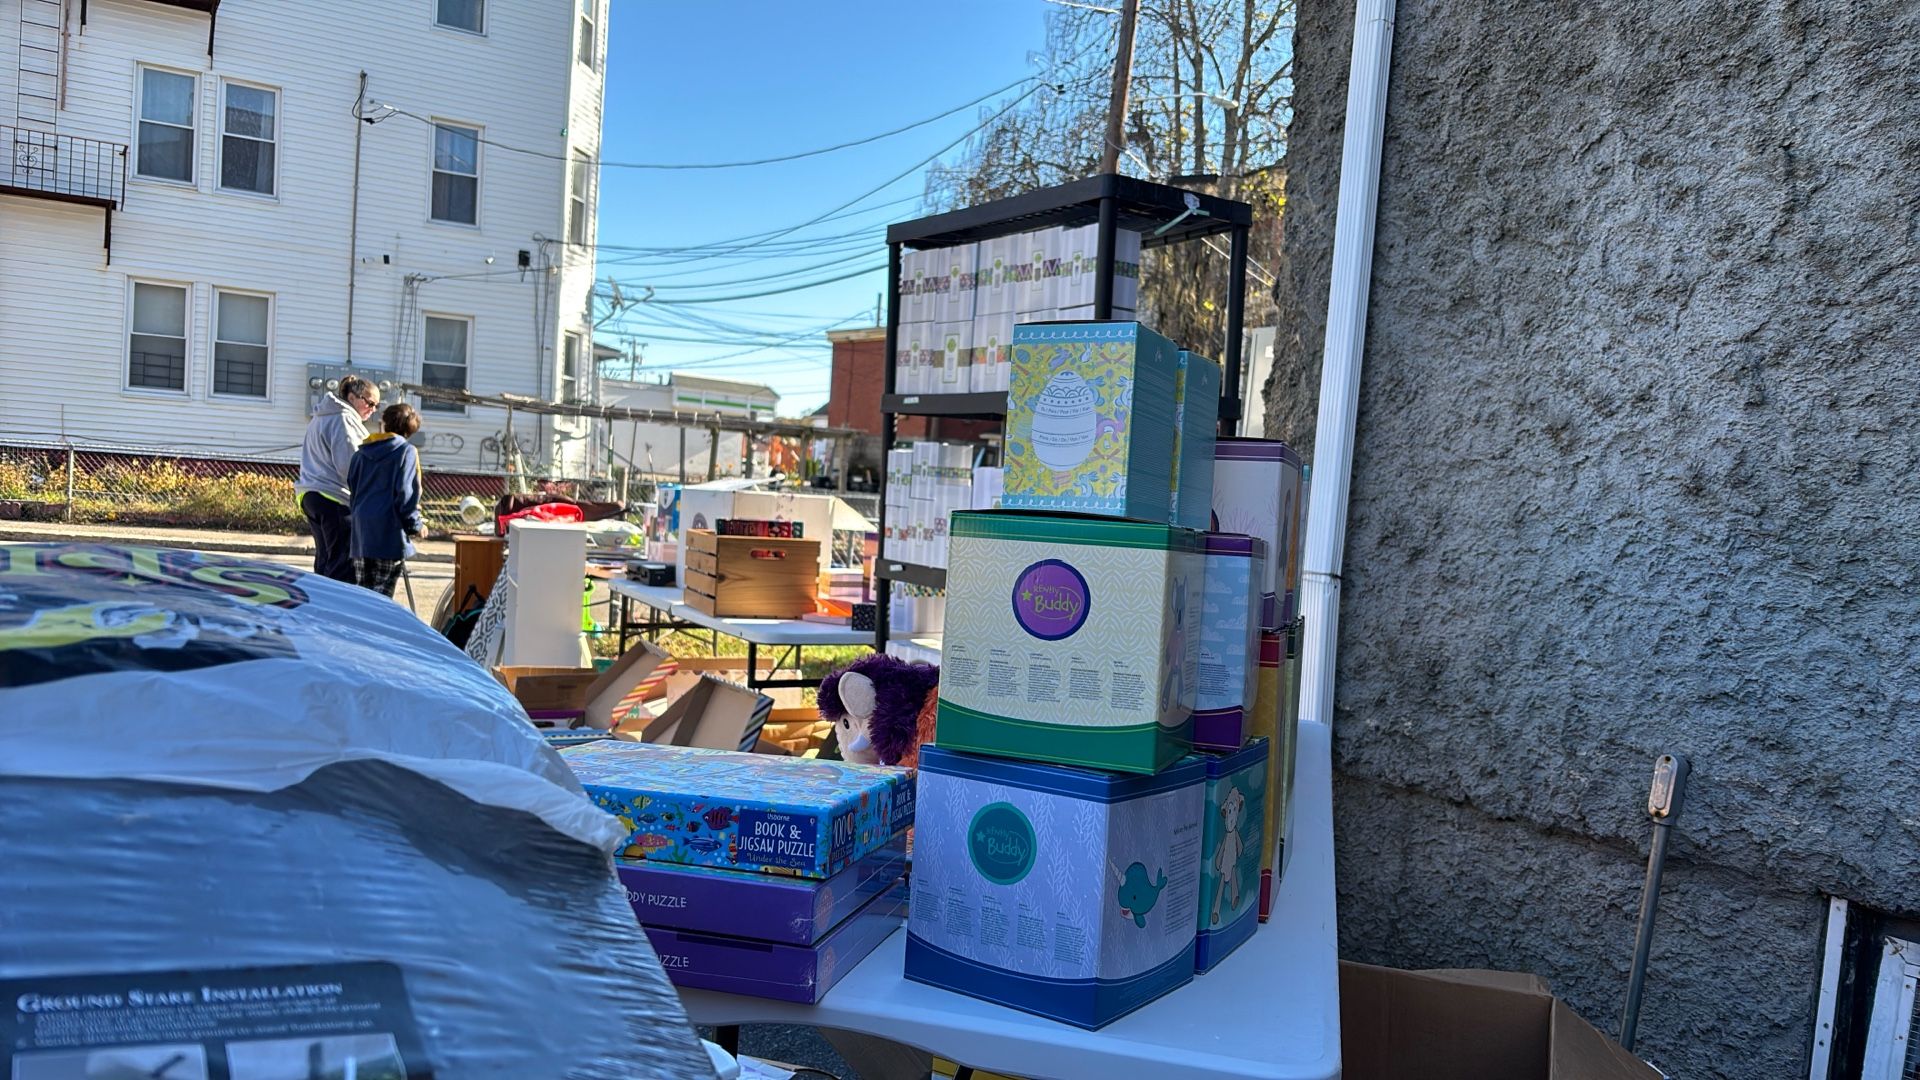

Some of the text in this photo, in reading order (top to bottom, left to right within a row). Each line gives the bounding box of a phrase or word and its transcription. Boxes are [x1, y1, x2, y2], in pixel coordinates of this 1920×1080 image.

[1034, 592, 1079, 621] Buddy
[755, 821, 802, 839] BOOK &
[738, 836, 815, 858] JIGSAW PUZZLE
[987, 837, 1026, 867] Buddy
[746, 852, 772, 862] Under
[789, 859, 806, 868] Sea
[626, 890, 687, 908] DDY PUZZLE
[660, 954, 690, 968] ZZLE
